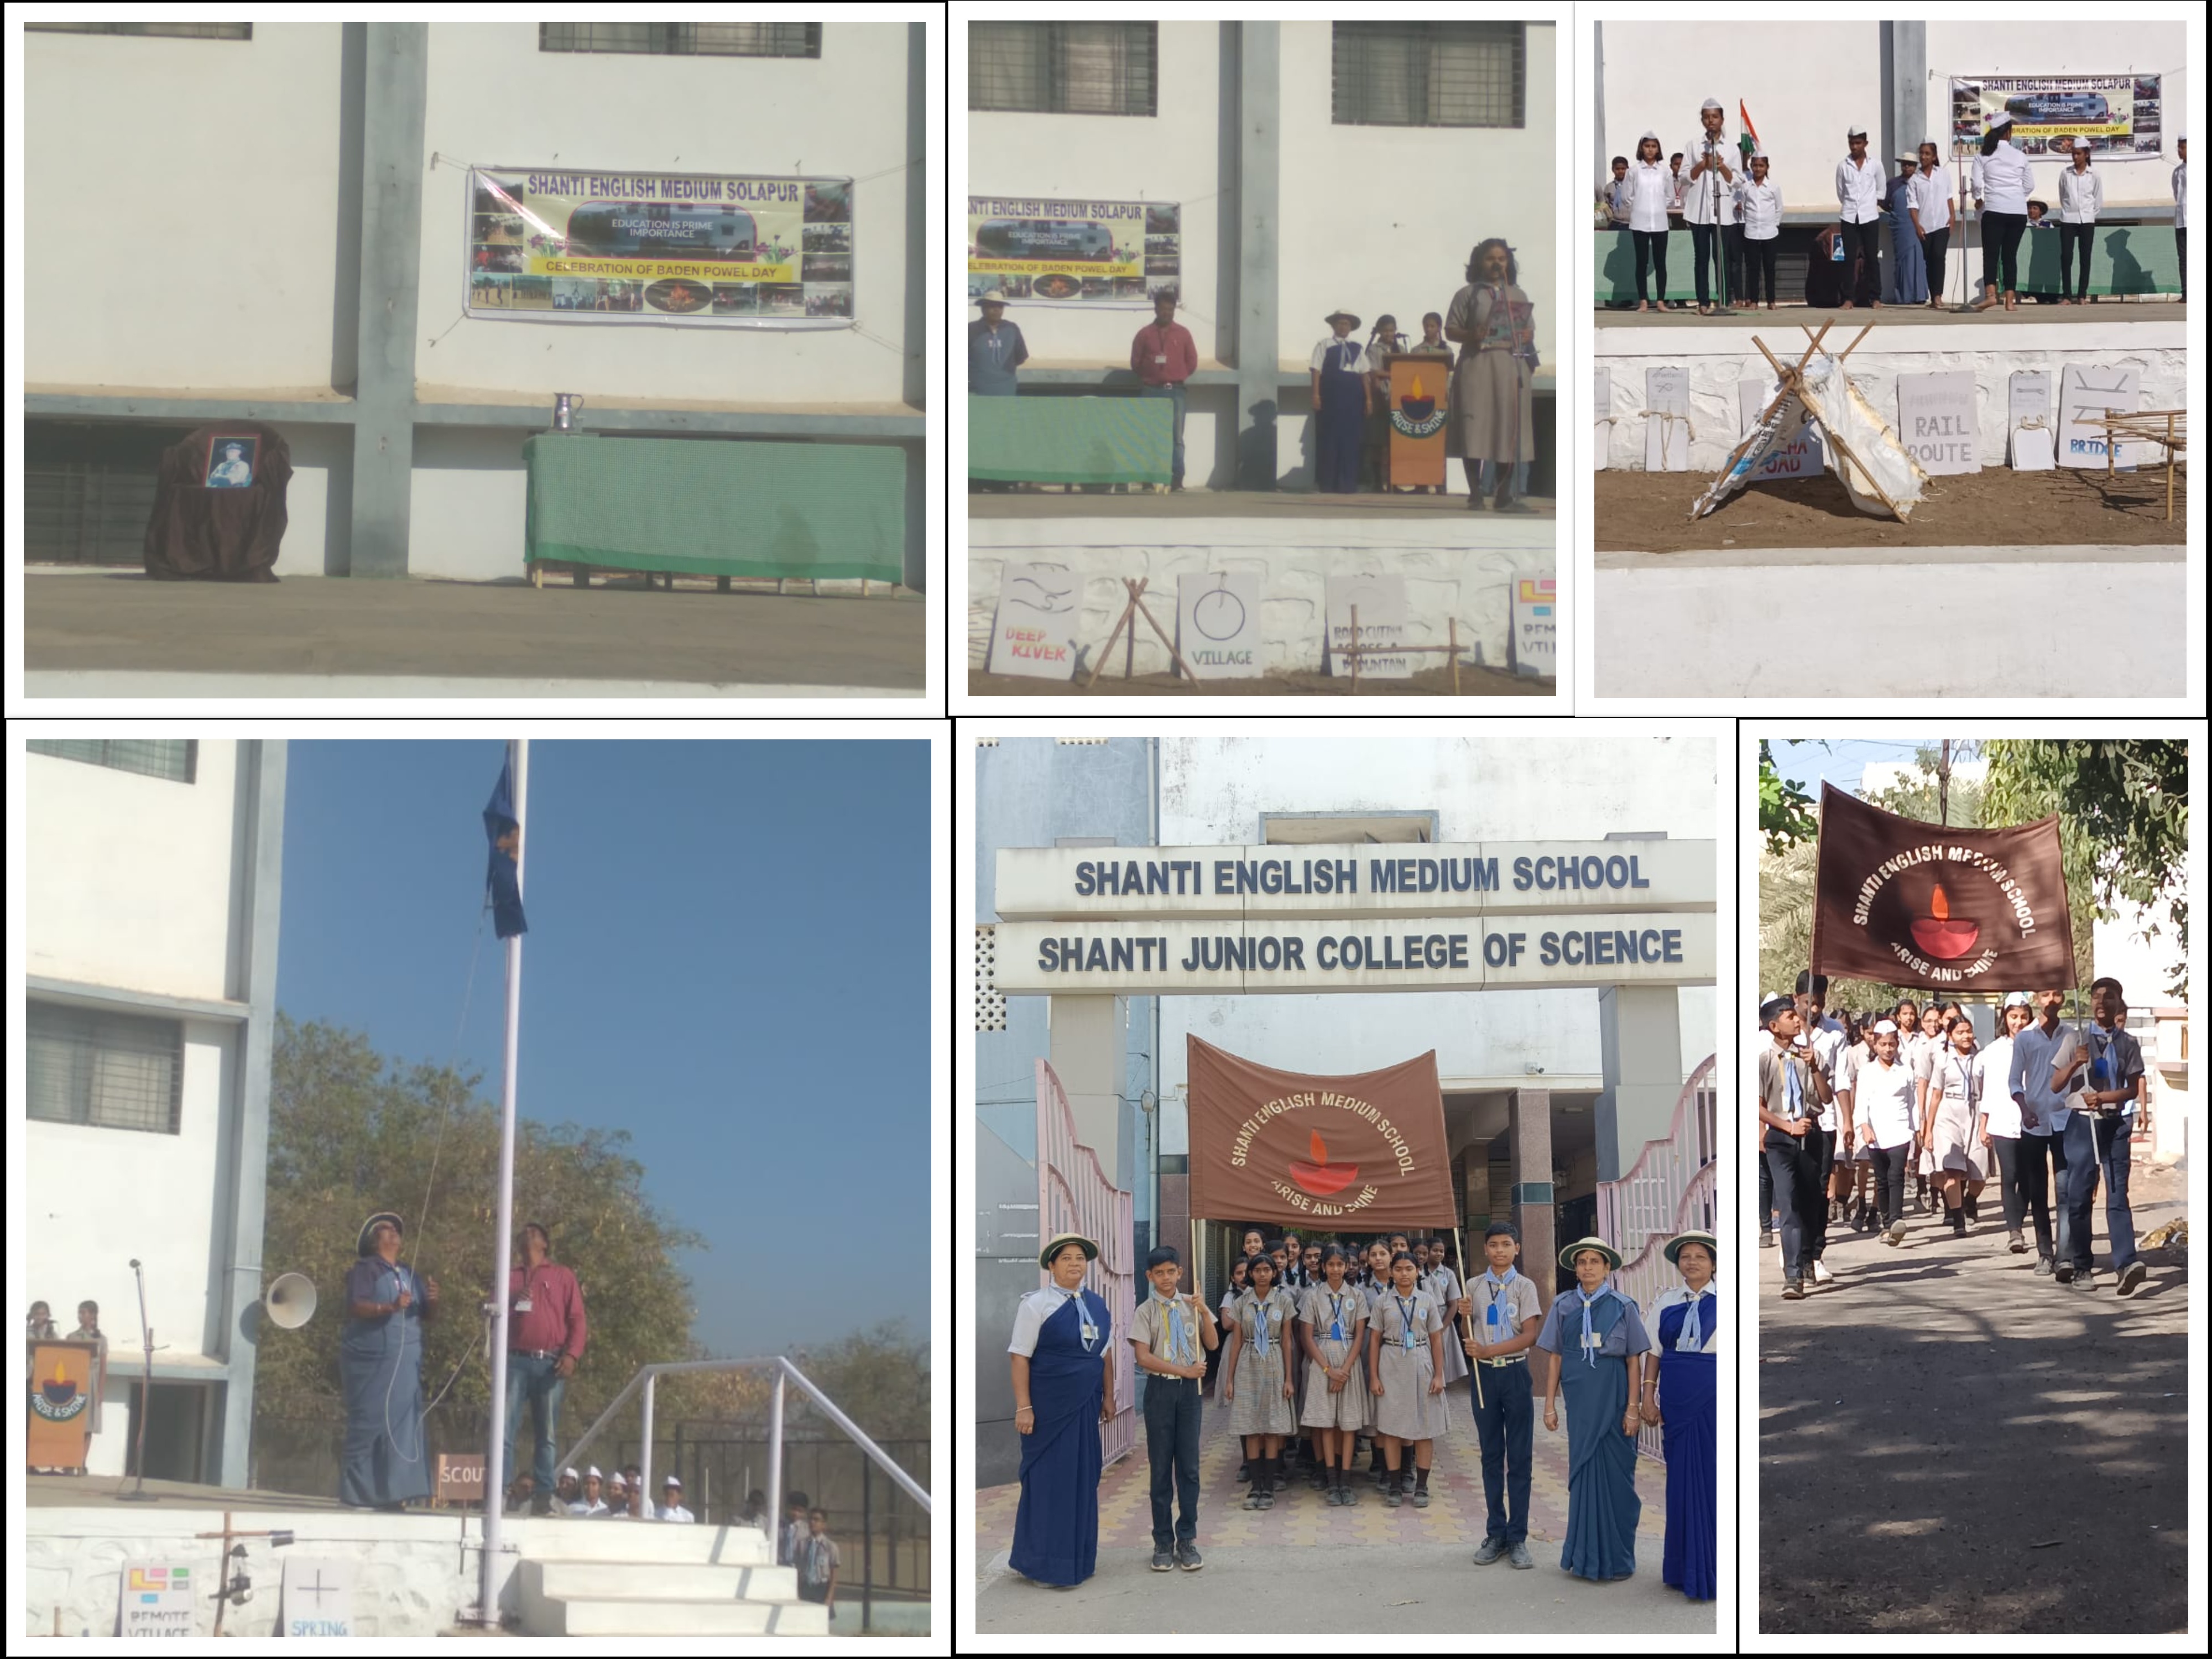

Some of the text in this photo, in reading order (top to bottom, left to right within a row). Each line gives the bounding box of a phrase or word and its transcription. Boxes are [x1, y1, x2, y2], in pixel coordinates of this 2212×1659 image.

[1982, 77, 2131, 91] SHANTI ENGLISH MEDIUM SOLAPUR
[528, 175, 799, 202] SHANTI ENGLISH MEDIUM SOLAPUR
[992, 201, 1040, 217] ENGLISH
[1044, 203, 1088, 218] MEDIUM
[1091, 205, 1142, 220] SOLAPUR
[612, 219, 713, 231] EDUCATION IS PRIME
[629, 228, 695, 238] IMPORTANCE
[546, 261, 778, 278] CELEBRATION OF BADEN POWEL DAY
[968, 263, 1024, 271] ELEBRATION
[1391, 410, 1446, 434] ARISE & SHINE
[1915, 415, 1970, 437] RAIL
[1908, 442, 1972, 462] ROUTE
[1005, 627, 1047, 643] DEEP
[1011, 644, 1067, 662] RIVER
[1191, 650, 1253, 665] VILLAGE
[1074, 855, 1650, 896] SHANTI ENGLISH MEDIUM SCHOOL
[1853, 874, 1884, 926] SHANTI
[1878, 844, 1943, 880] ENGLISH
[2000, 878, 2037, 940] SCHOOL
[1037, 929, 1683, 972] SHANTI JUNIOR COLLEGE OF SCIENCE
[1890, 942, 1929, 976] ARISE
[1930, 967, 1963, 982] AND
[1231, 1091, 1416, 1177] SHANTI ENGLISH MEDIUM SCHOOL
[1271, 1180, 1311, 1211] ARISE
[1312, 1202, 1344, 1215] AND
[32, 1394, 52, 1417] ARISE
[441, 1465, 486, 1483] SCOU
[291, 1619, 348, 1637] SPRING
